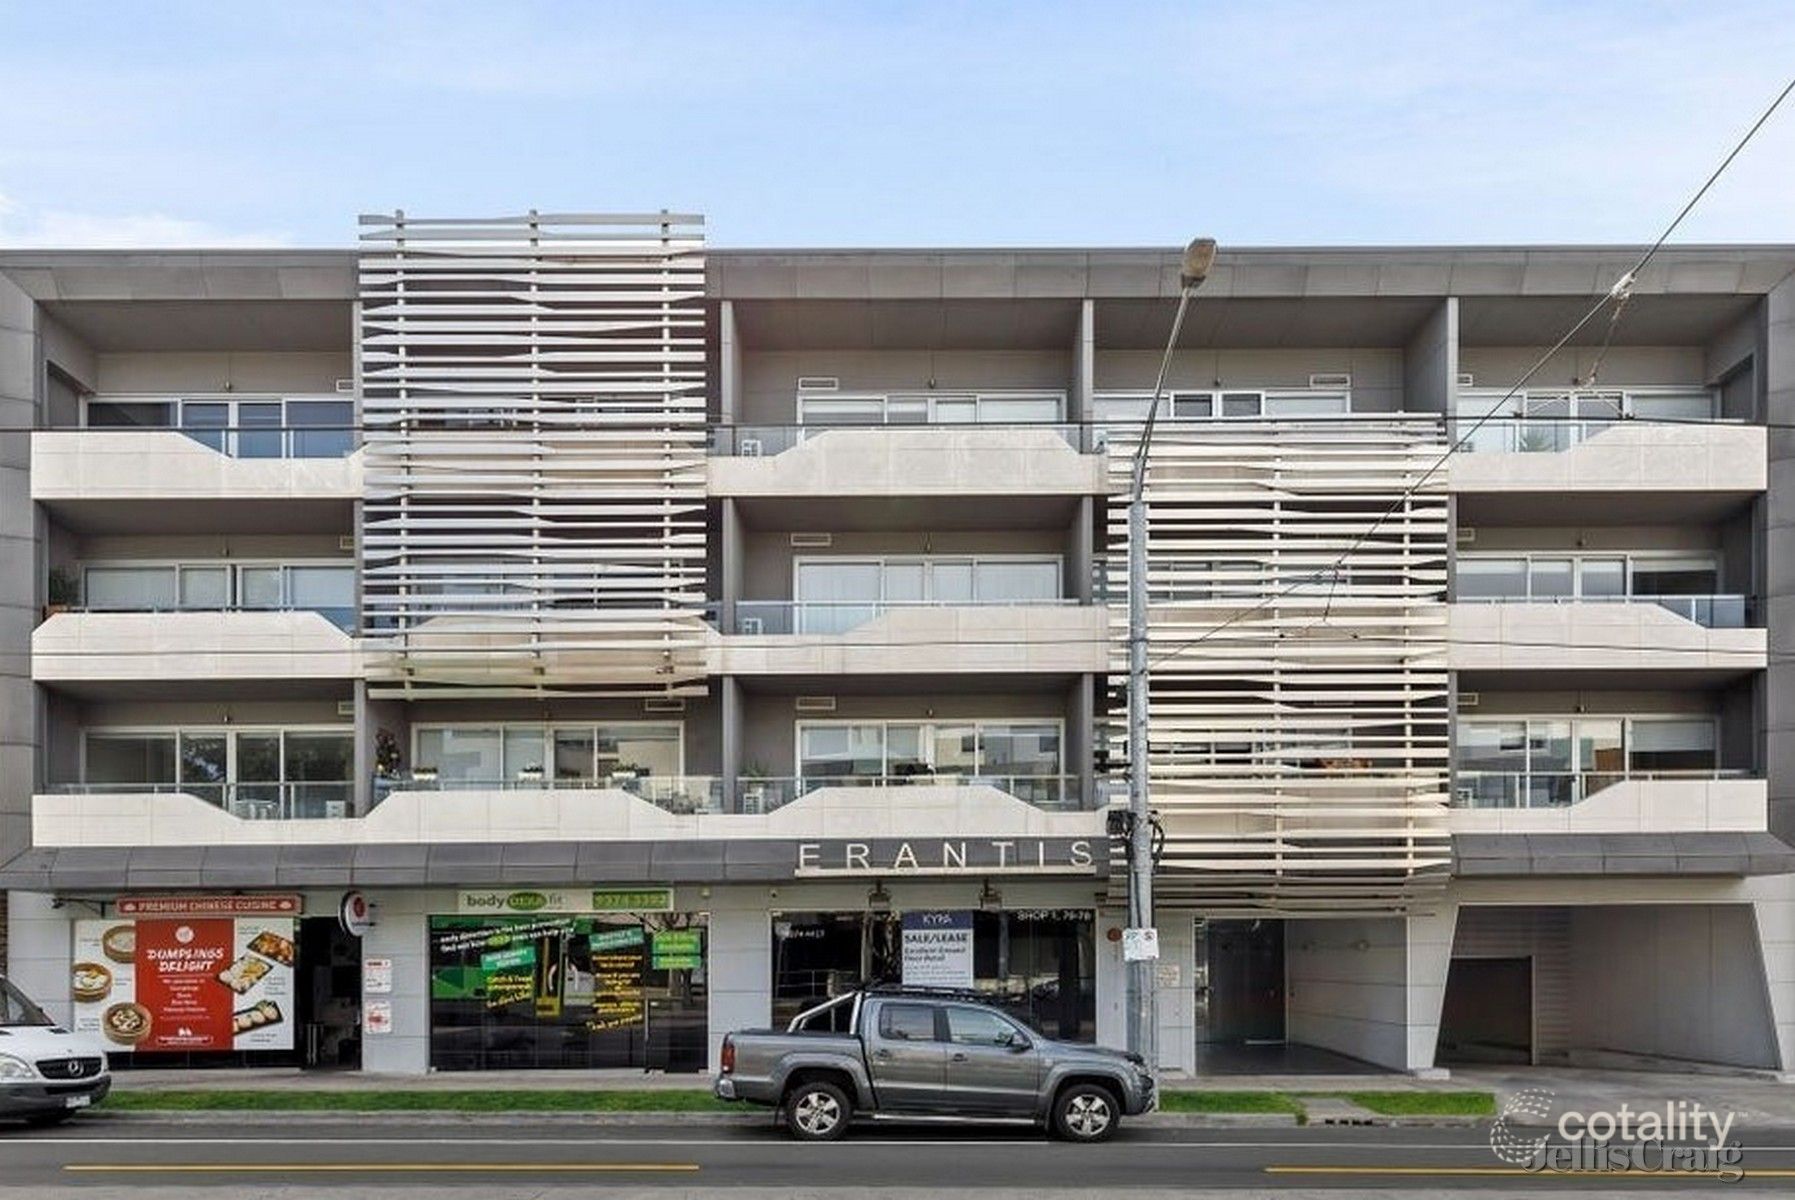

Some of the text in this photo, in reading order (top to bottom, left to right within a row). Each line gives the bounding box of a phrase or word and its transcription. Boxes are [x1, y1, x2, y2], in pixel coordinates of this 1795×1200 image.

[799, 840, 1094, 869] ERANTIS
[138, 899, 278, 912] PREMIUM CHINESE CUISINE
[467, 894, 505, 907] body
[1017, 910, 1049, 921] SHOP
[904, 933, 968, 945] SALE/LEASE
[147, 949, 225, 961] DUMPLINGS
[158, 961, 214, 973] DELIGHT
